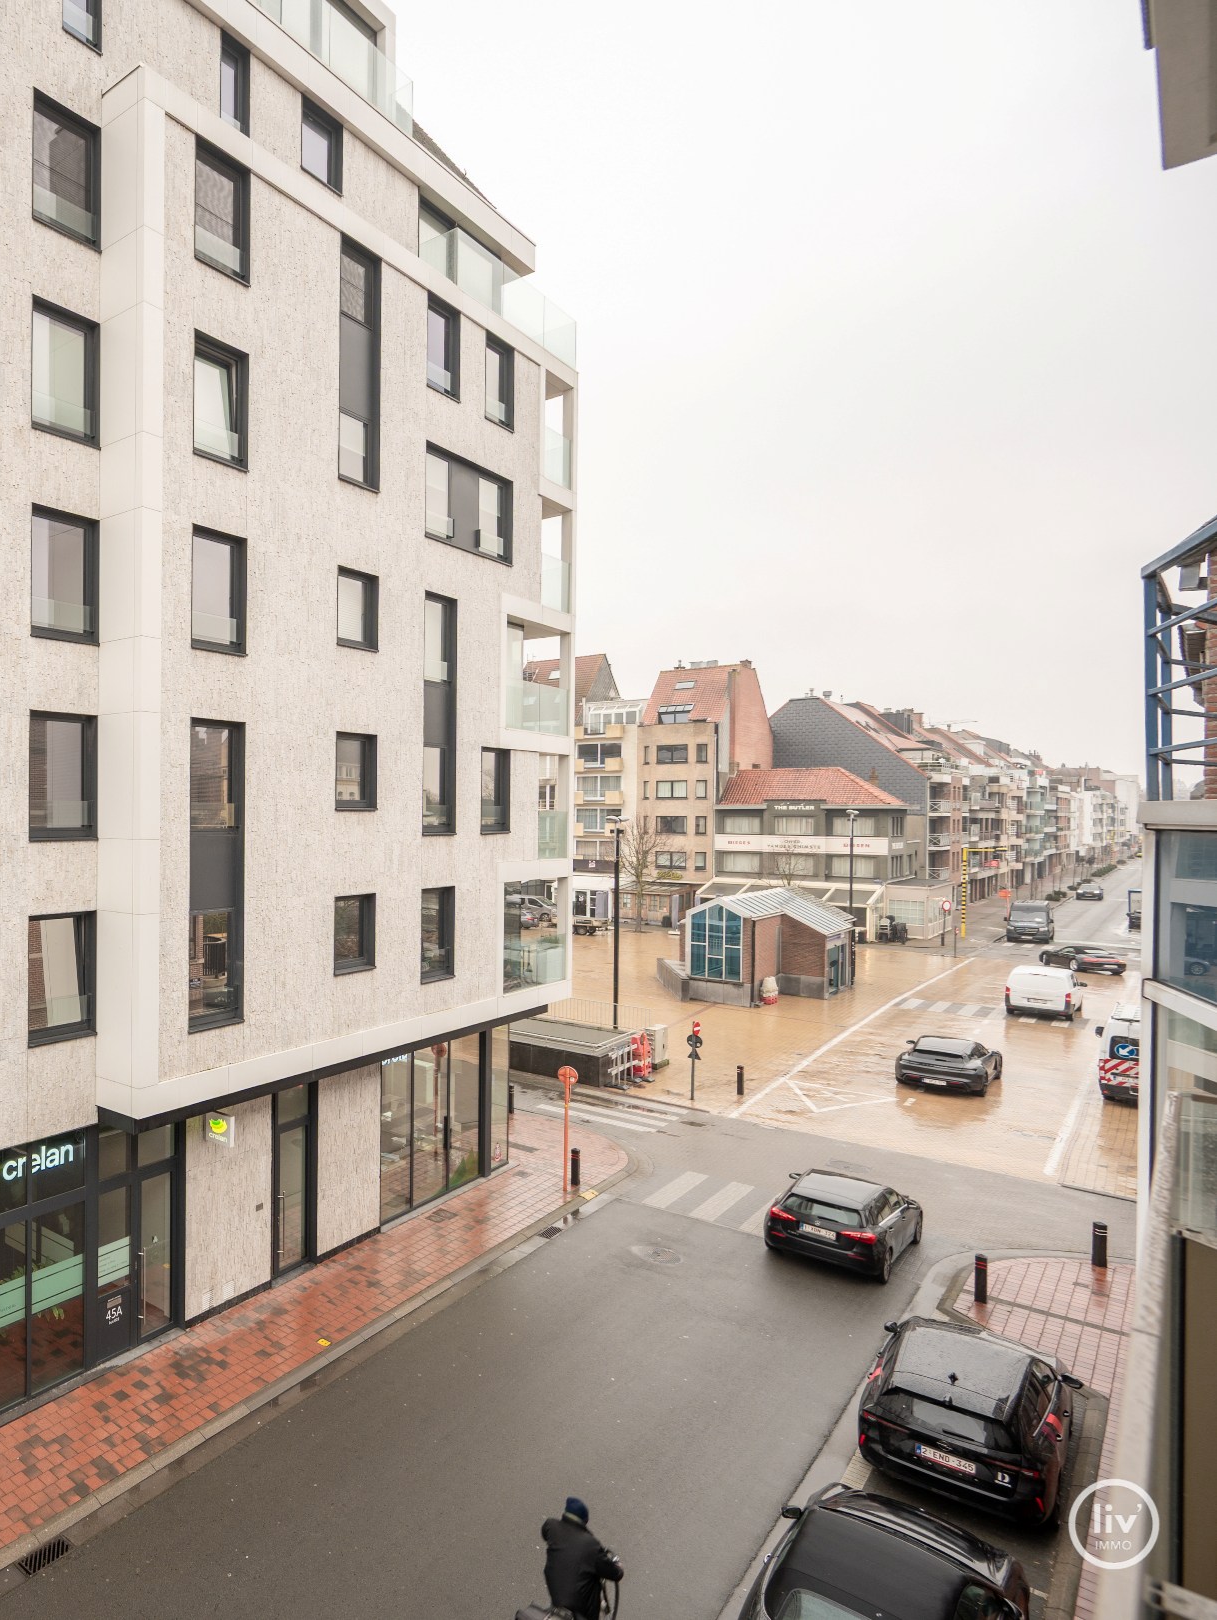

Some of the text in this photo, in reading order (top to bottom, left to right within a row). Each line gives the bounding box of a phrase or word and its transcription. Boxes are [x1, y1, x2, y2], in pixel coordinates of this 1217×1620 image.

[208, 1132, 228, 1143] crelan
[3, 1144, 73, 1180] crelan
[105, 1305, 123, 1321] 45A
